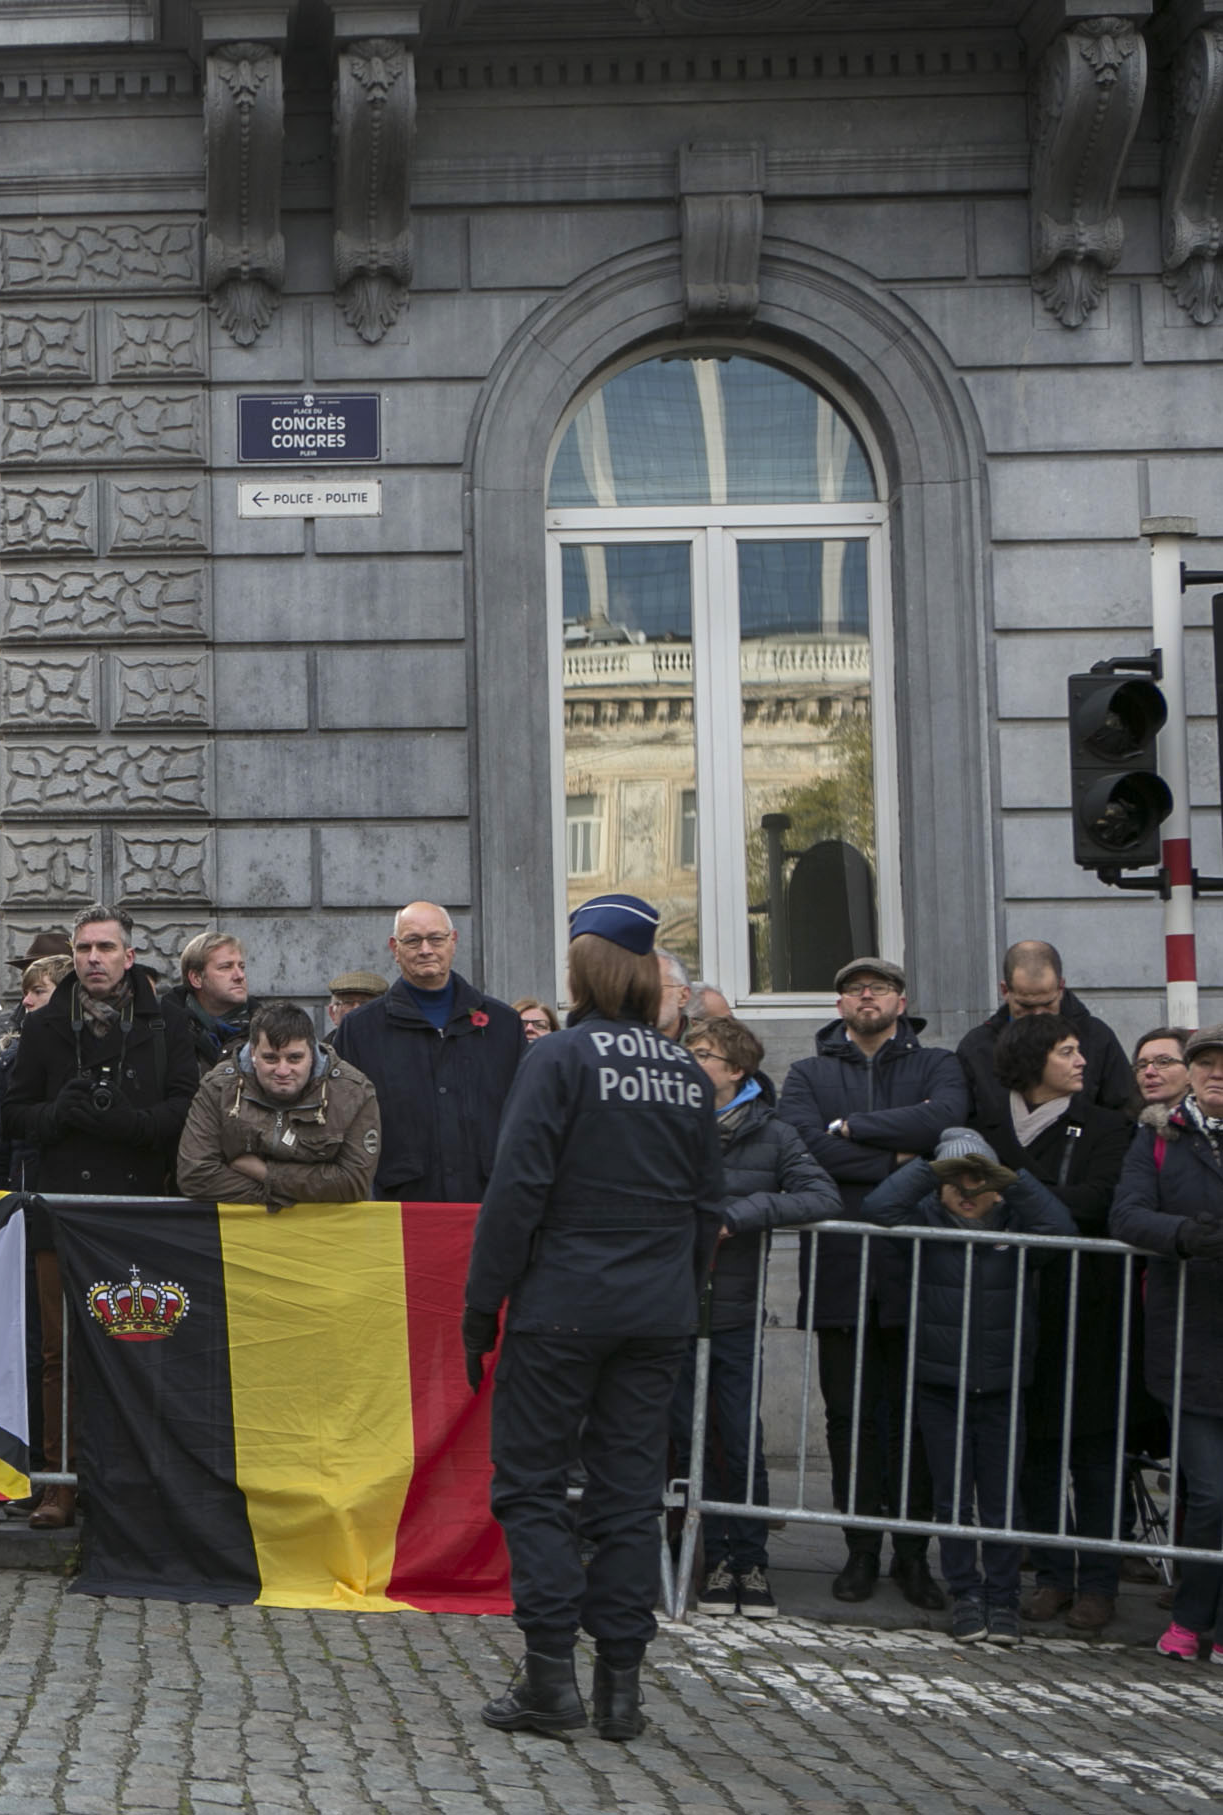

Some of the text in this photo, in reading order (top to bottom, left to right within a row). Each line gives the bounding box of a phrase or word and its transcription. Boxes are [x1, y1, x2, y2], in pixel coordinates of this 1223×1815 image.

[271, 413, 346, 431] CONGRÈS
[271, 434, 346, 448] CONGRES
[273, 493, 313, 504] POLICE
[325, 492, 368, 503] POLITIE
[590, 1027, 692, 1065] Police
[598, 1066, 703, 1109] Politie
